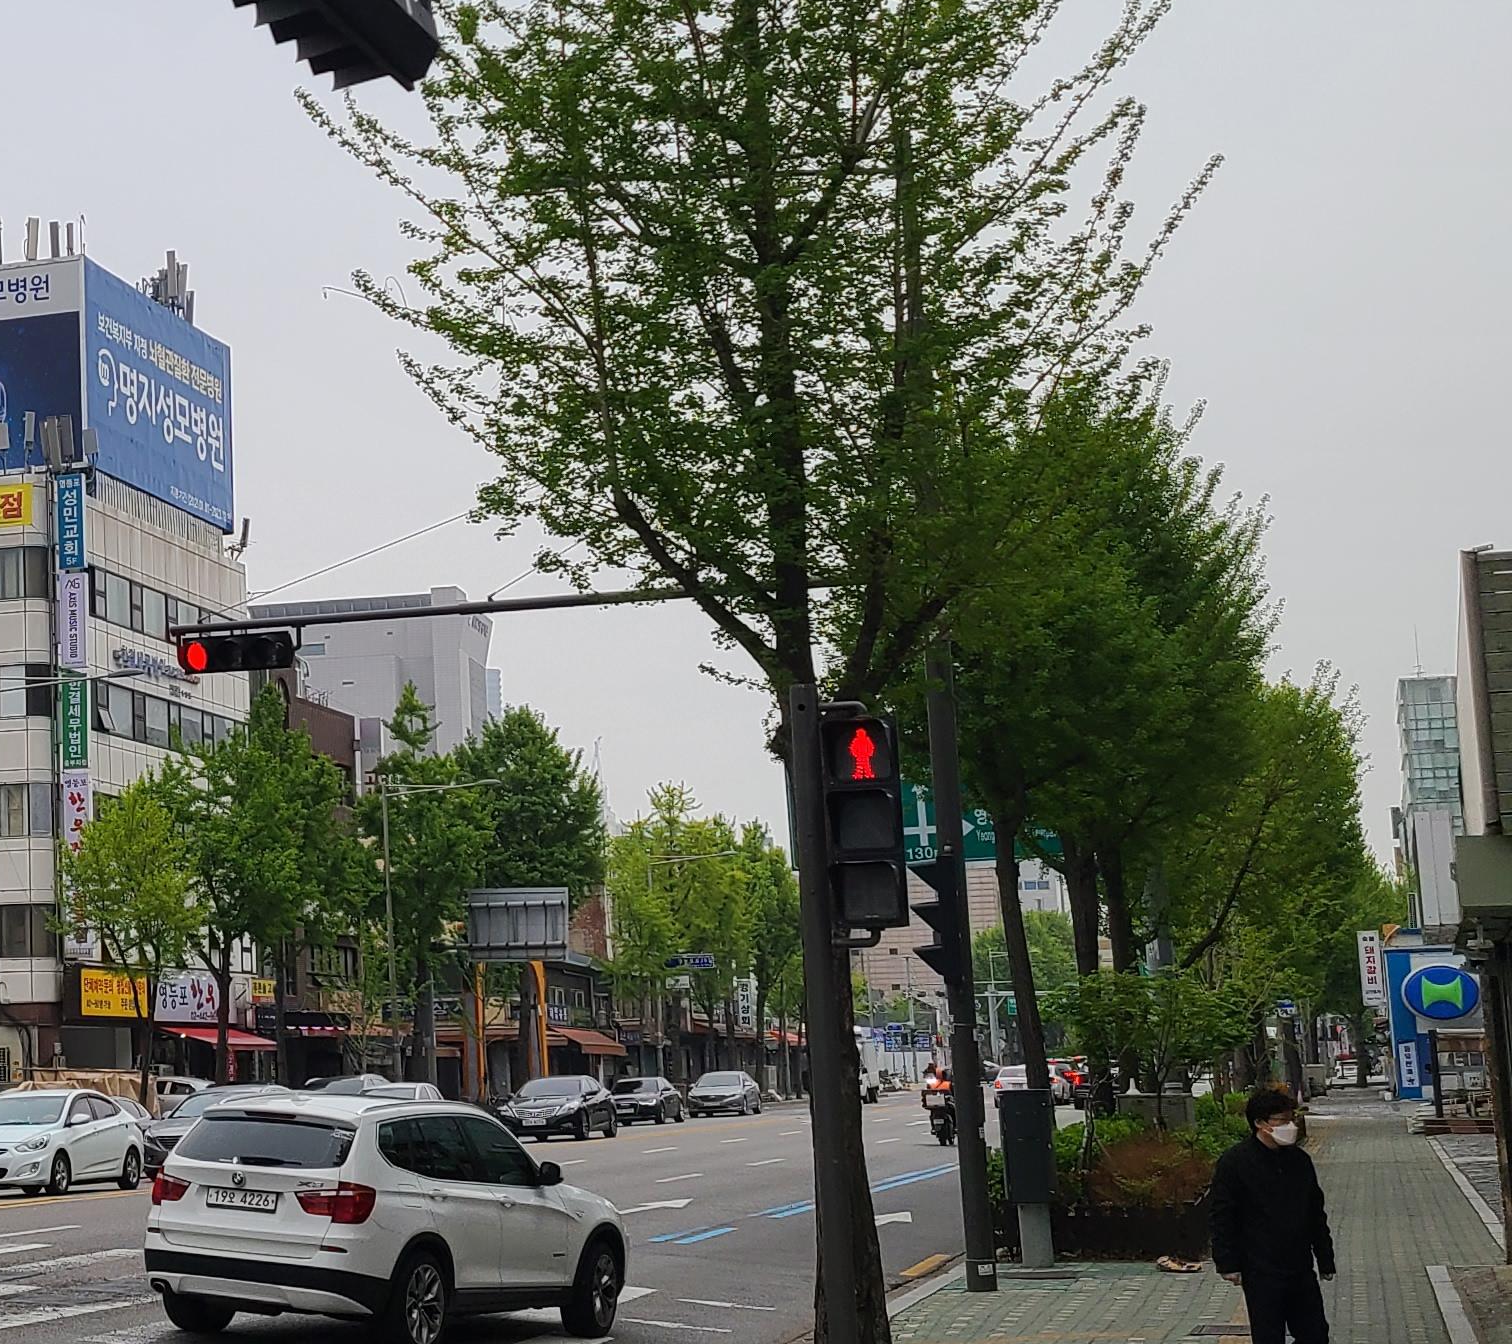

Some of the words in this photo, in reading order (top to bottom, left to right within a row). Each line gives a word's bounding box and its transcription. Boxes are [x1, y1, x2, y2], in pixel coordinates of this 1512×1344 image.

[97, 311, 133, 349] 보건복지부
[133, 336, 148, 360] 지정
[148, 338, 191, 385] 뇌혈관질환
[190, 365, 223, 405] 전문병원
[119, 362, 225, 473] 명지성모병원
[61, 488, 80, 556] 성민교회
[65, 556, 78, 566] 5F
[68, 609, 78, 632] MUSIC
[69, 632, 79, 659] STUDIO
[64, 778, 88, 789] 영등포
[1364, 945, 1378, 986] 돼지갈비
[158, 981, 189, 1010] 영등포
[214, 1189, 236, 1204] 19오
[239, 1192, 270, 1207] 4226
